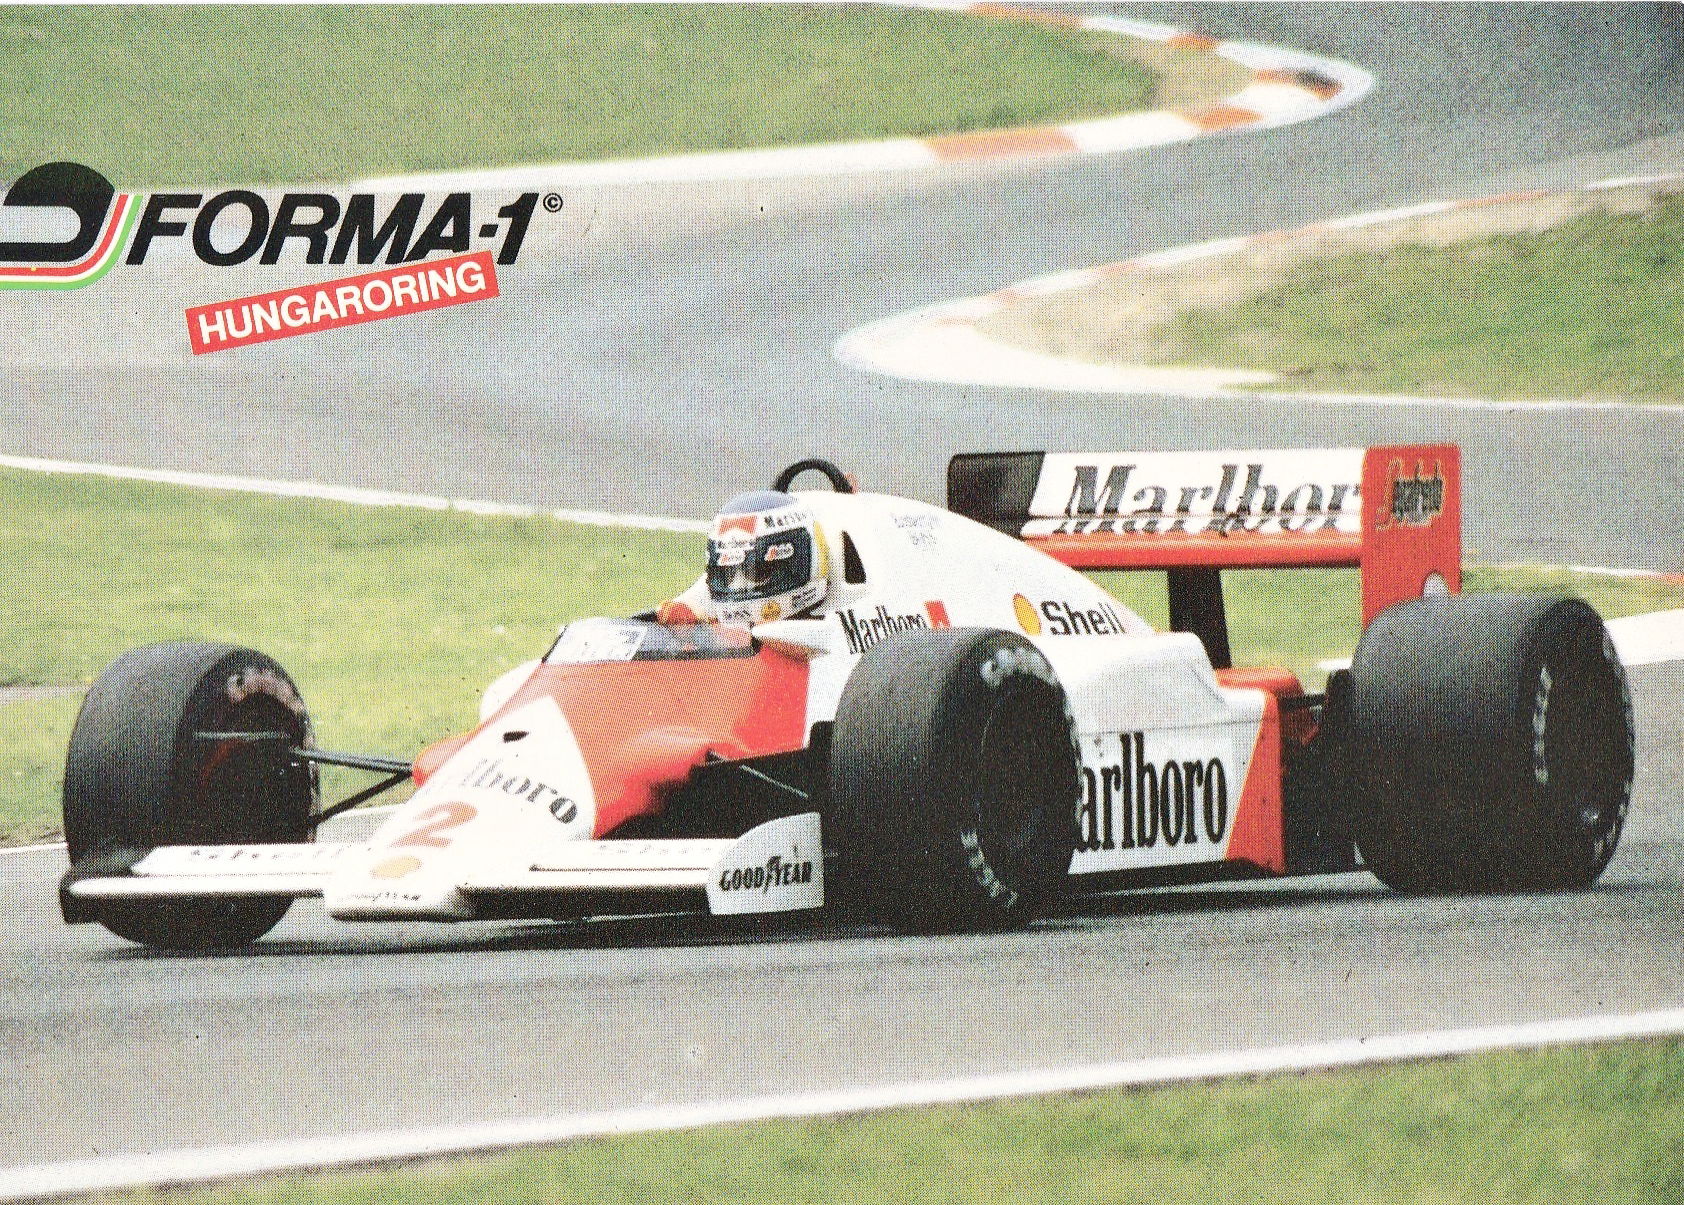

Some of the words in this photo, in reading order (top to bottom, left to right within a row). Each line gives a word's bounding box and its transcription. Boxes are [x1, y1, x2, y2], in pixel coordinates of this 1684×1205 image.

[1053, 464, 1360, 535] Marlbor
[1041, 600, 1126, 635] Shell
[456, 757, 578, 824] lboro
[1076, 731, 1227, 853] arlboro
[388, 801, 479, 849] 2
[719, 855, 813, 894] GOODYEAR
